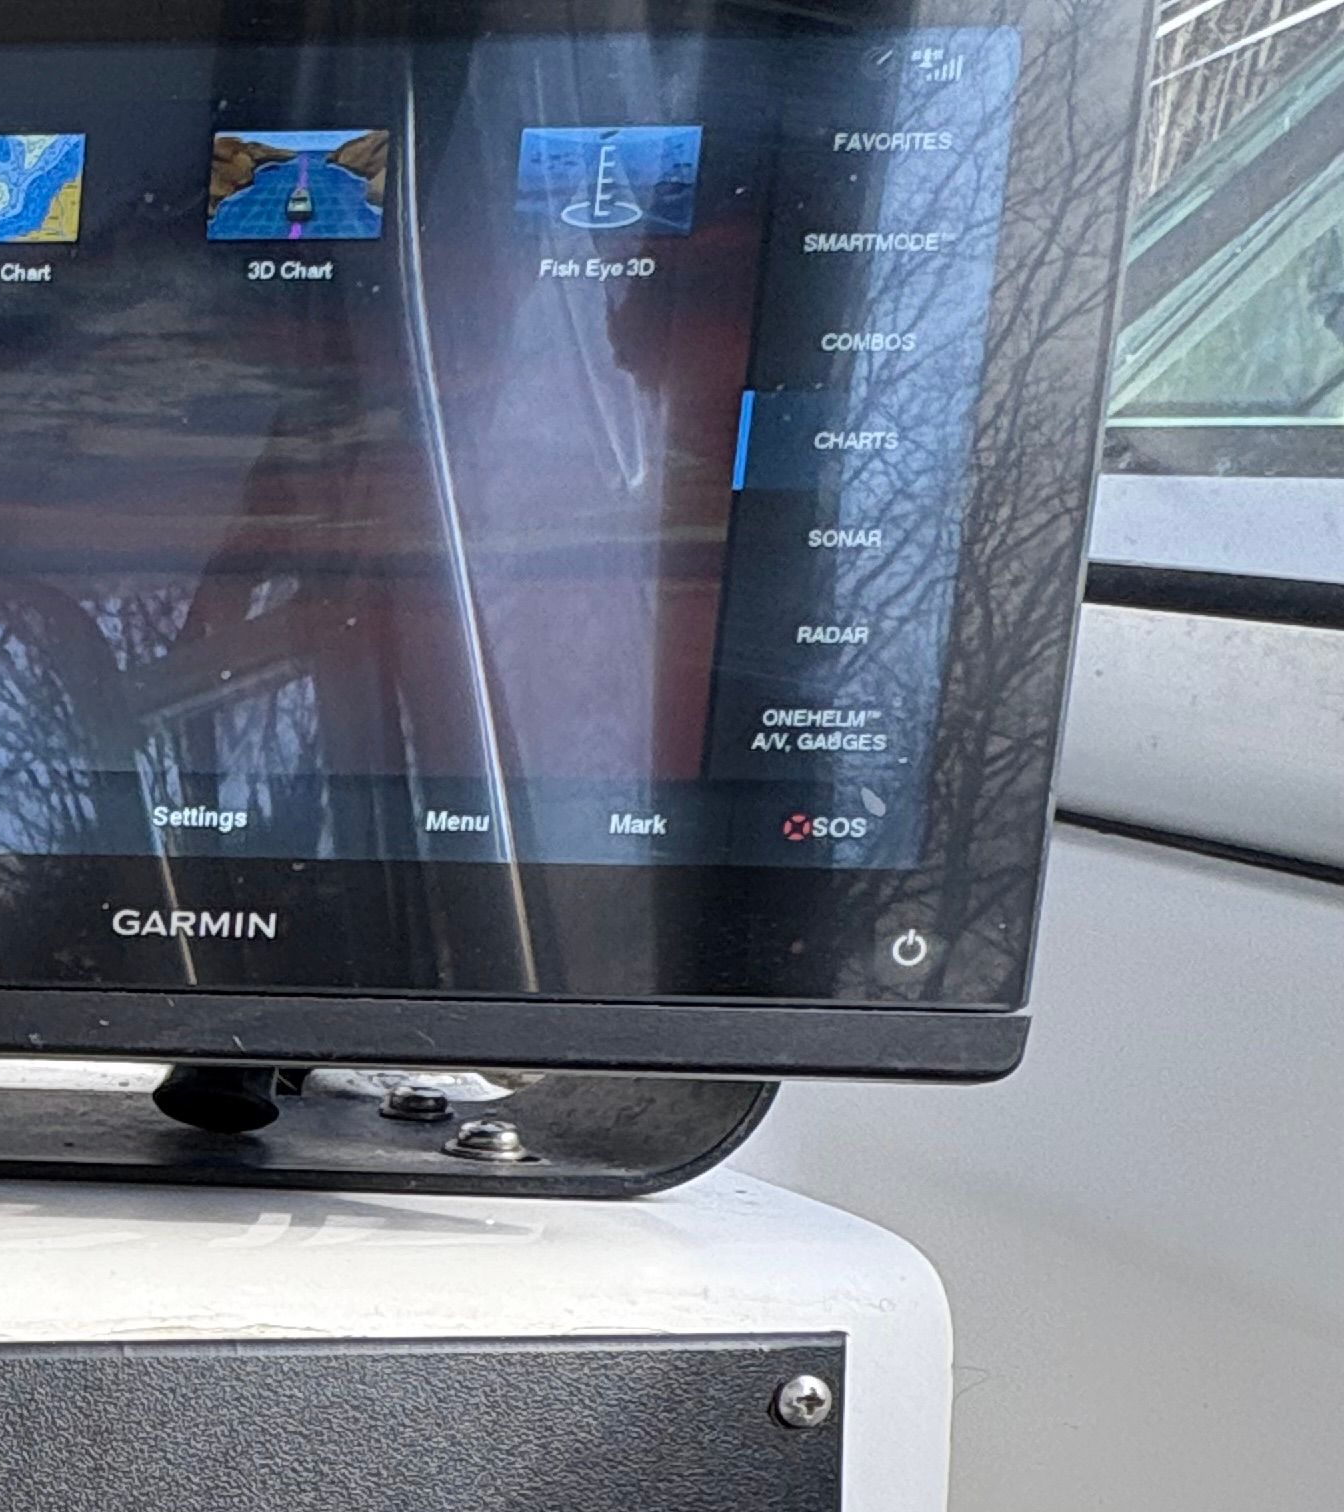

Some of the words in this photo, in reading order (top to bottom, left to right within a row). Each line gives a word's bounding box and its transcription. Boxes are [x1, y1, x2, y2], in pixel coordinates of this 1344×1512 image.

[833, 132, 953, 151] FAVORITES
[0, 262, 51, 283] Chart
[247, 261, 275, 280] 3D
[280, 260, 333, 281] Chart
[539, 258, 580, 278] Fish
[584, 259, 624, 280] Eye
[627, 258, 655, 277] 3D
[820, 332, 917, 351] COMBOS
[813, 431, 900, 450] CHARTS
[808, 529, 882, 548] SONAR
[796, 626, 869, 644] RADAR
[750, 733, 792, 753] A/V,
[797, 732, 887, 752] GAUGES
[153, 806, 248, 830] Settings
[425, 811, 490, 832] Menu
[610, 813, 667, 835] Mark
[812, 818, 867, 838] SOS
[111, 909, 278, 939] GARMIN
